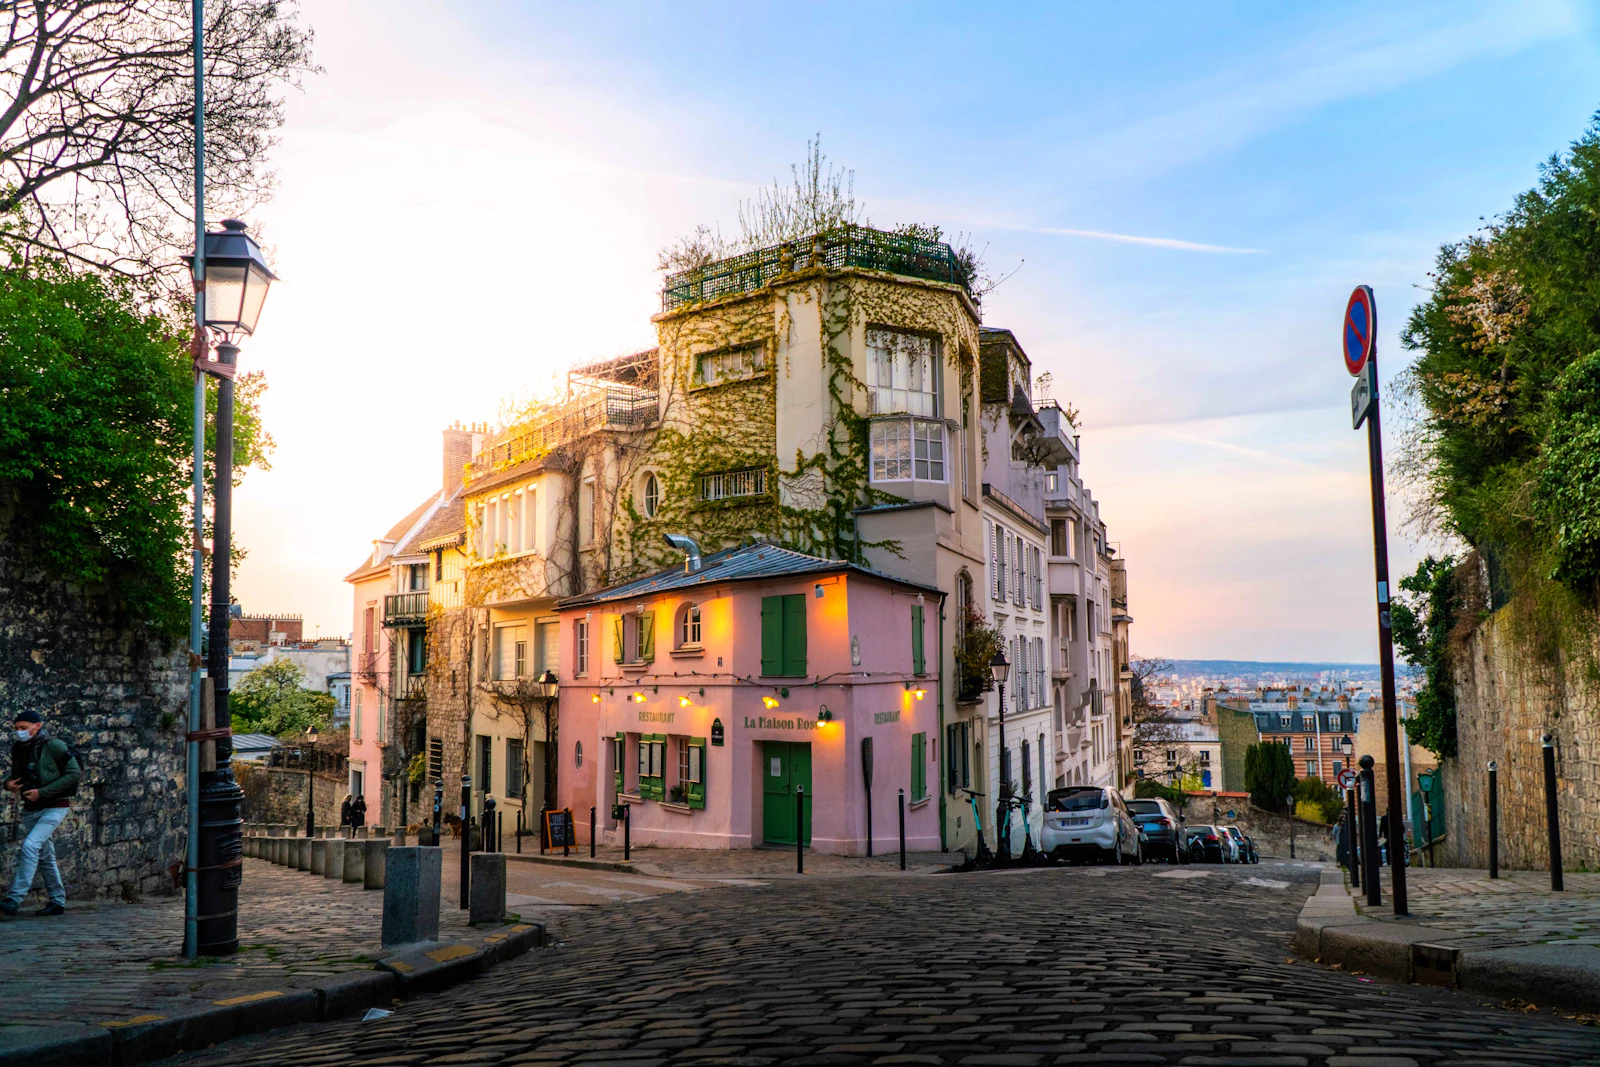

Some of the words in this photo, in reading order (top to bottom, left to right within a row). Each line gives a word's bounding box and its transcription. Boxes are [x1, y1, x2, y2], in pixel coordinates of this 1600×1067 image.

[638, 711, 675, 724] RESTAURANT
[744, 716, 756, 729] La
[758, 716, 794, 730] Maison
[874, 710, 900, 725] RESTAURANT
